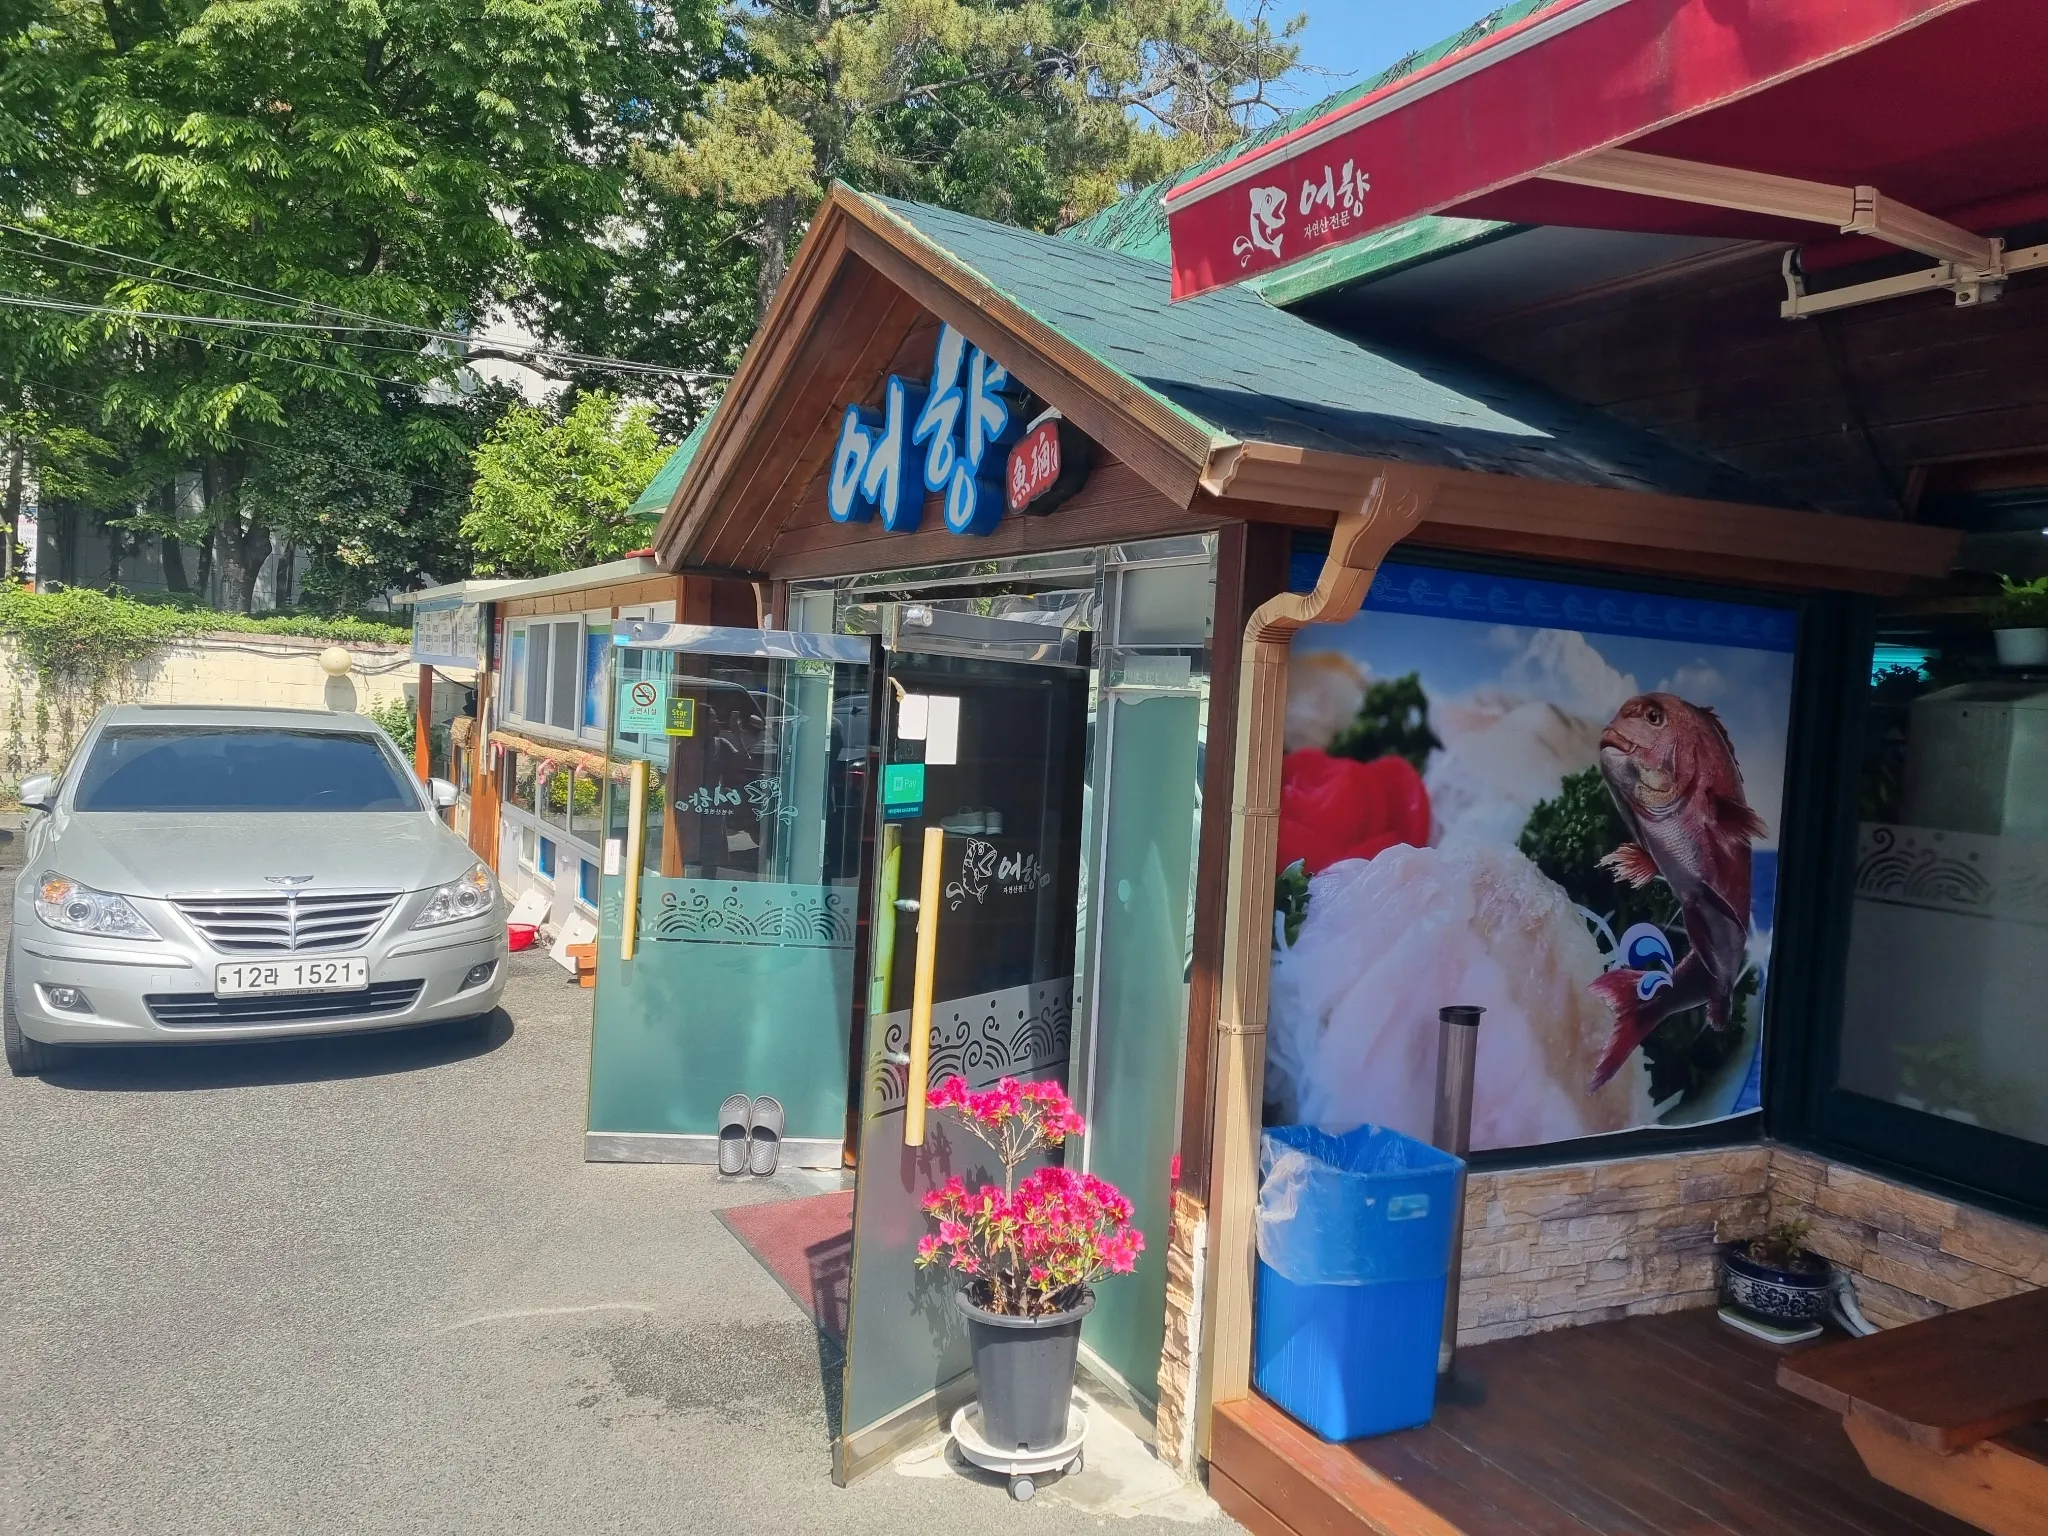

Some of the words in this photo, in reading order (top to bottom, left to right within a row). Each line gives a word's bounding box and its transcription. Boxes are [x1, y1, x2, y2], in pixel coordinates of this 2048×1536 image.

[1299, 158, 1371, 217] 어향
[1303, 210, 1351, 240] 자연산전문
[829, 322, 1008, 533] 어향
[671, 708, 688, 716] Star
[904, 779, 917, 789] Pay
[998, 851, 1042, 890] 어향
[232, 967, 279, 988] 12라
[294, 962, 350, 985] 1521
